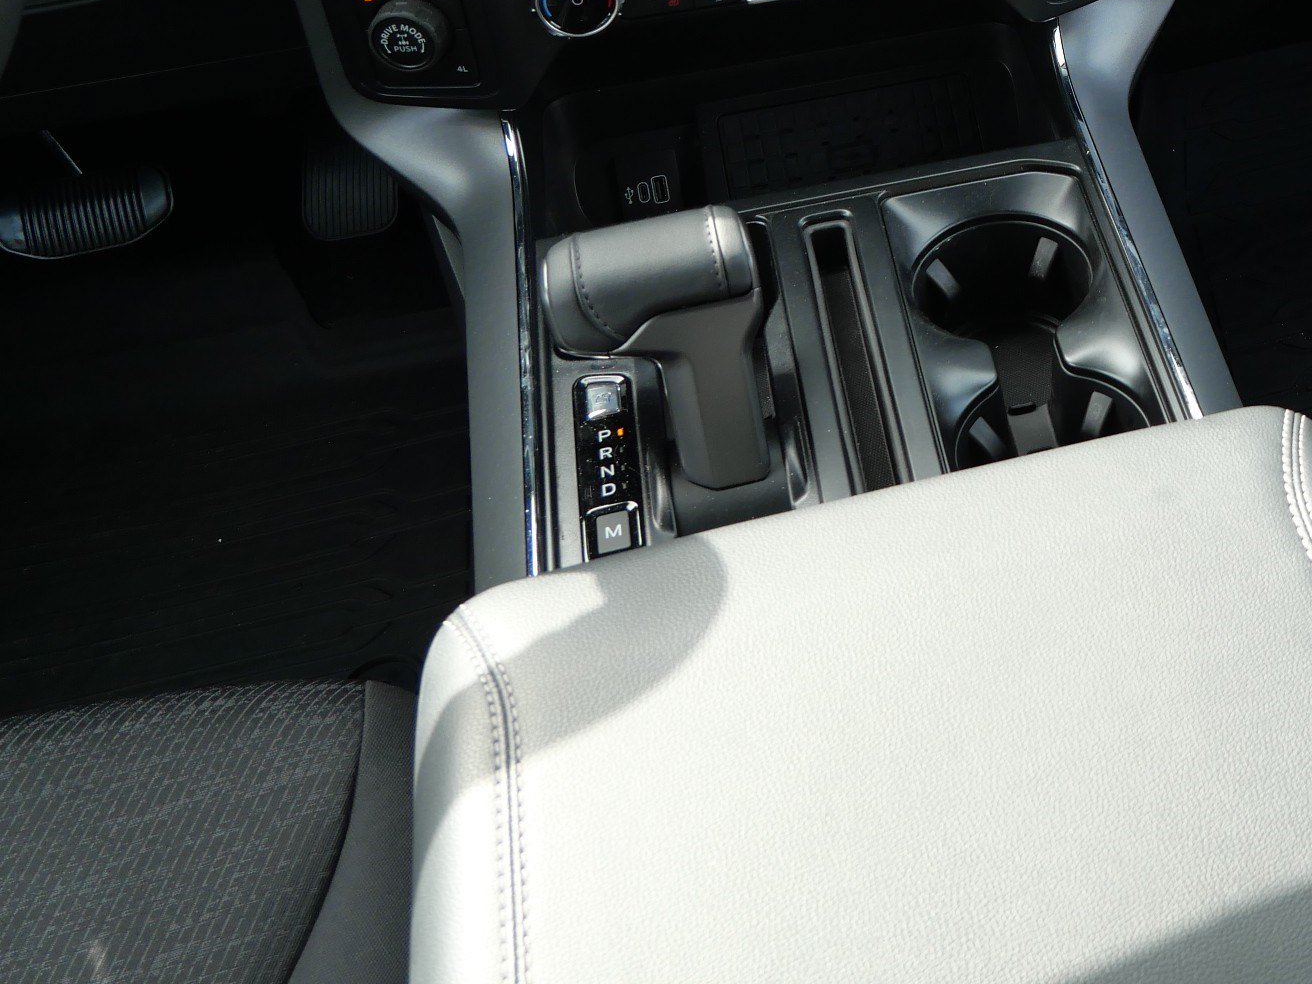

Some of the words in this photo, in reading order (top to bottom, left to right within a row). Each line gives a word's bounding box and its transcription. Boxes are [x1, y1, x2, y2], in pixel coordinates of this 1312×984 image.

[381, 24, 398, 45] DRIVE
[400, 24, 426, 44] MODE
[598, 429, 612, 443] P
[599, 447, 613, 460] R
[601, 464, 615, 478] N
[602, 483, 616, 497] D
[605, 524, 622, 539] M
